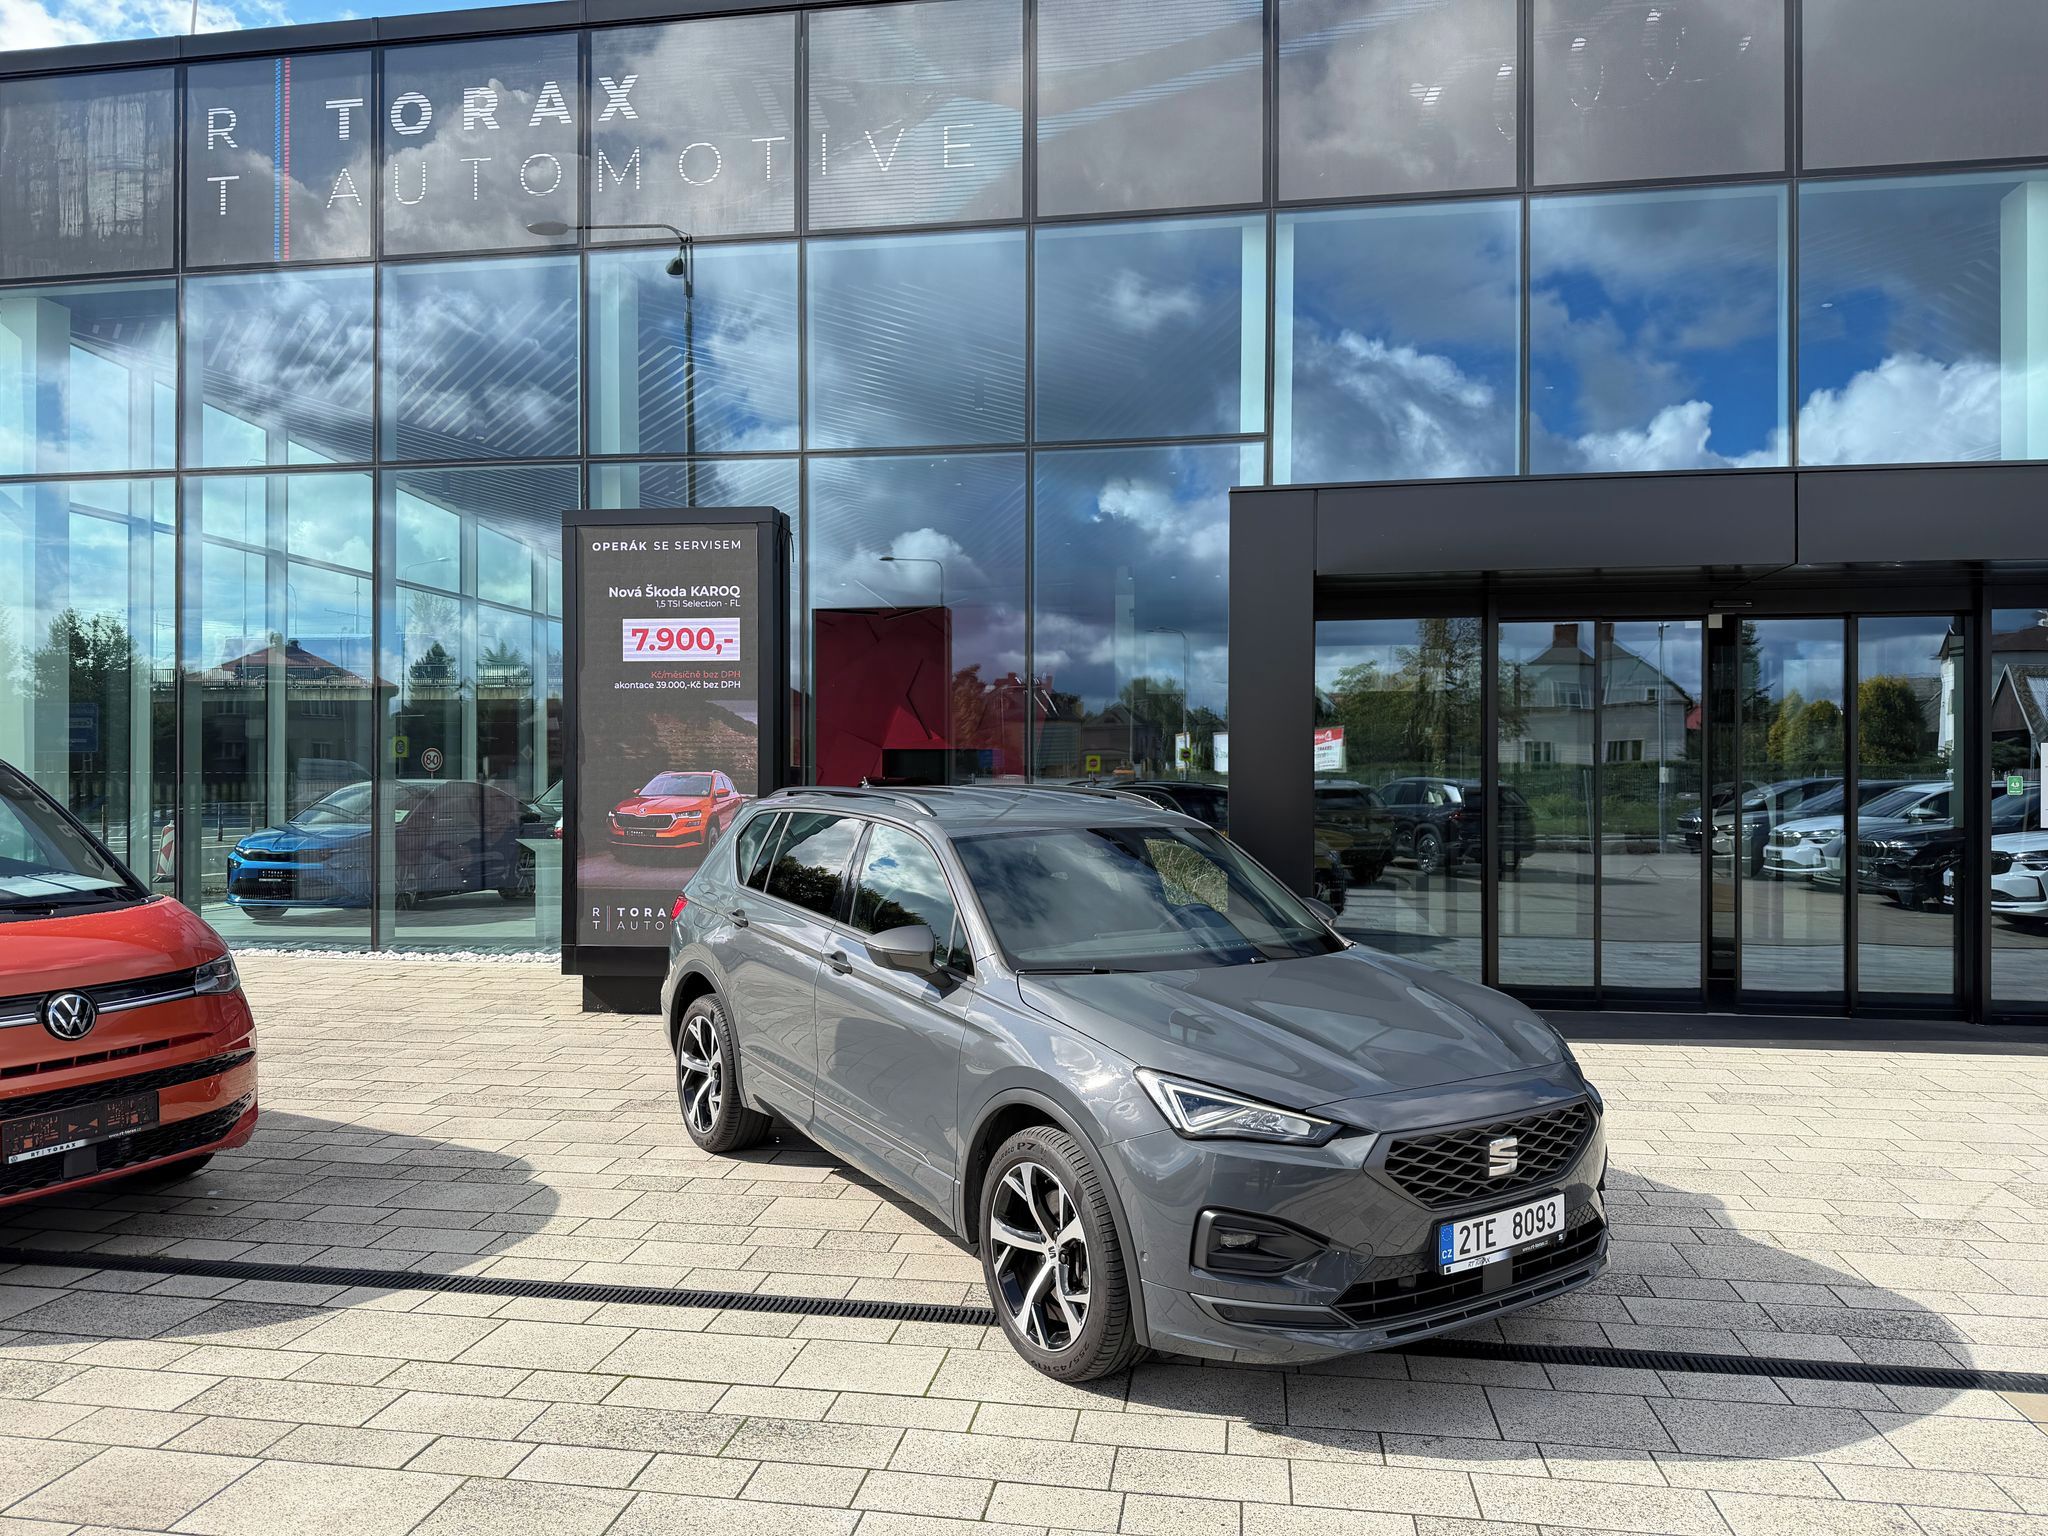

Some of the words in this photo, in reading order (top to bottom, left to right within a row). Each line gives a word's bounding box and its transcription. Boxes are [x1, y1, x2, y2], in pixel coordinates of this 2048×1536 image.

[207, 107, 238, 150] R
[325, 73, 639, 141] TORAX
[206, 175, 240, 216] T
[325, 123, 976, 209] AUTOMOTIVE
[592, 539, 647, 551] OPERÁK
[653, 541, 669, 550] SE
[674, 540, 741, 550] SERVISEM
[608, 586, 642, 598] Nová
[645, 584, 687, 598] Škoda
[690, 585, 741, 598] KAROQ
[668, 600, 681, 608] TSI
[682, 599, 722, 608] Selection
[730, 599, 741, 607] FL
[631, 627, 734, 655] 7.900,-
[703, 671, 719, 679] bez
[721, 670, 741, 678] DPH
[614, 682, 655, 690] akontace
[656, 680, 701, 690] 39.000,-Kč
[703, 681, 719, 689] bez
[721, 681, 741, 689] DPH
[592, 907, 600, 917] R
[592, 920, 600, 930] T
[47, 1142, 76, 1153] TORAX
[1459, 1218, 1497, 1256] 2TE
[1512, 1201, 1556, 1240] 8093
[1441, 1249, 1453, 1259] CZ
